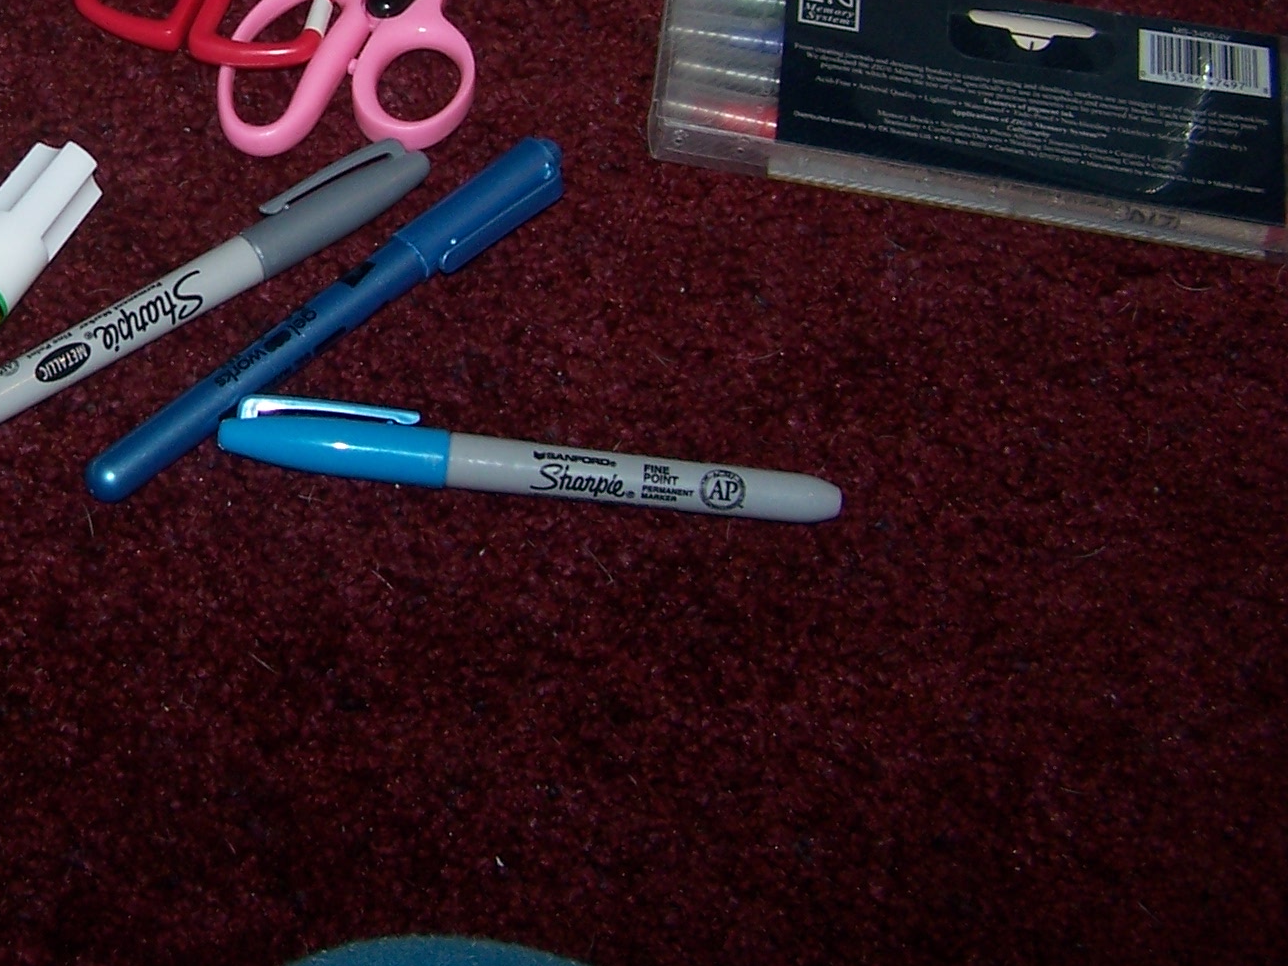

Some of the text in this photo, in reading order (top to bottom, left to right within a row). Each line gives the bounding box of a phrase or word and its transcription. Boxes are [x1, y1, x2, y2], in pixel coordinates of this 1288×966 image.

[805, 3, 855, 20] Memory
[805, 11, 851, 26] System
[93, 270, 204, 353] Sharpie
[288, 309, 318, 337] gel
[37, 343, 89, 381] METALLIC
[214, 348, 268, 388] works
[546, 452, 611, 466] SANFORD
[643, 463, 670, 475] FINE
[530, 463, 626, 498] Sharpie
[643, 473, 680, 485] POINT
[640, 492, 678, 502] MARKER
[641, 485, 694, 498] PERMANENT
[709, 480, 739, 502] AP
